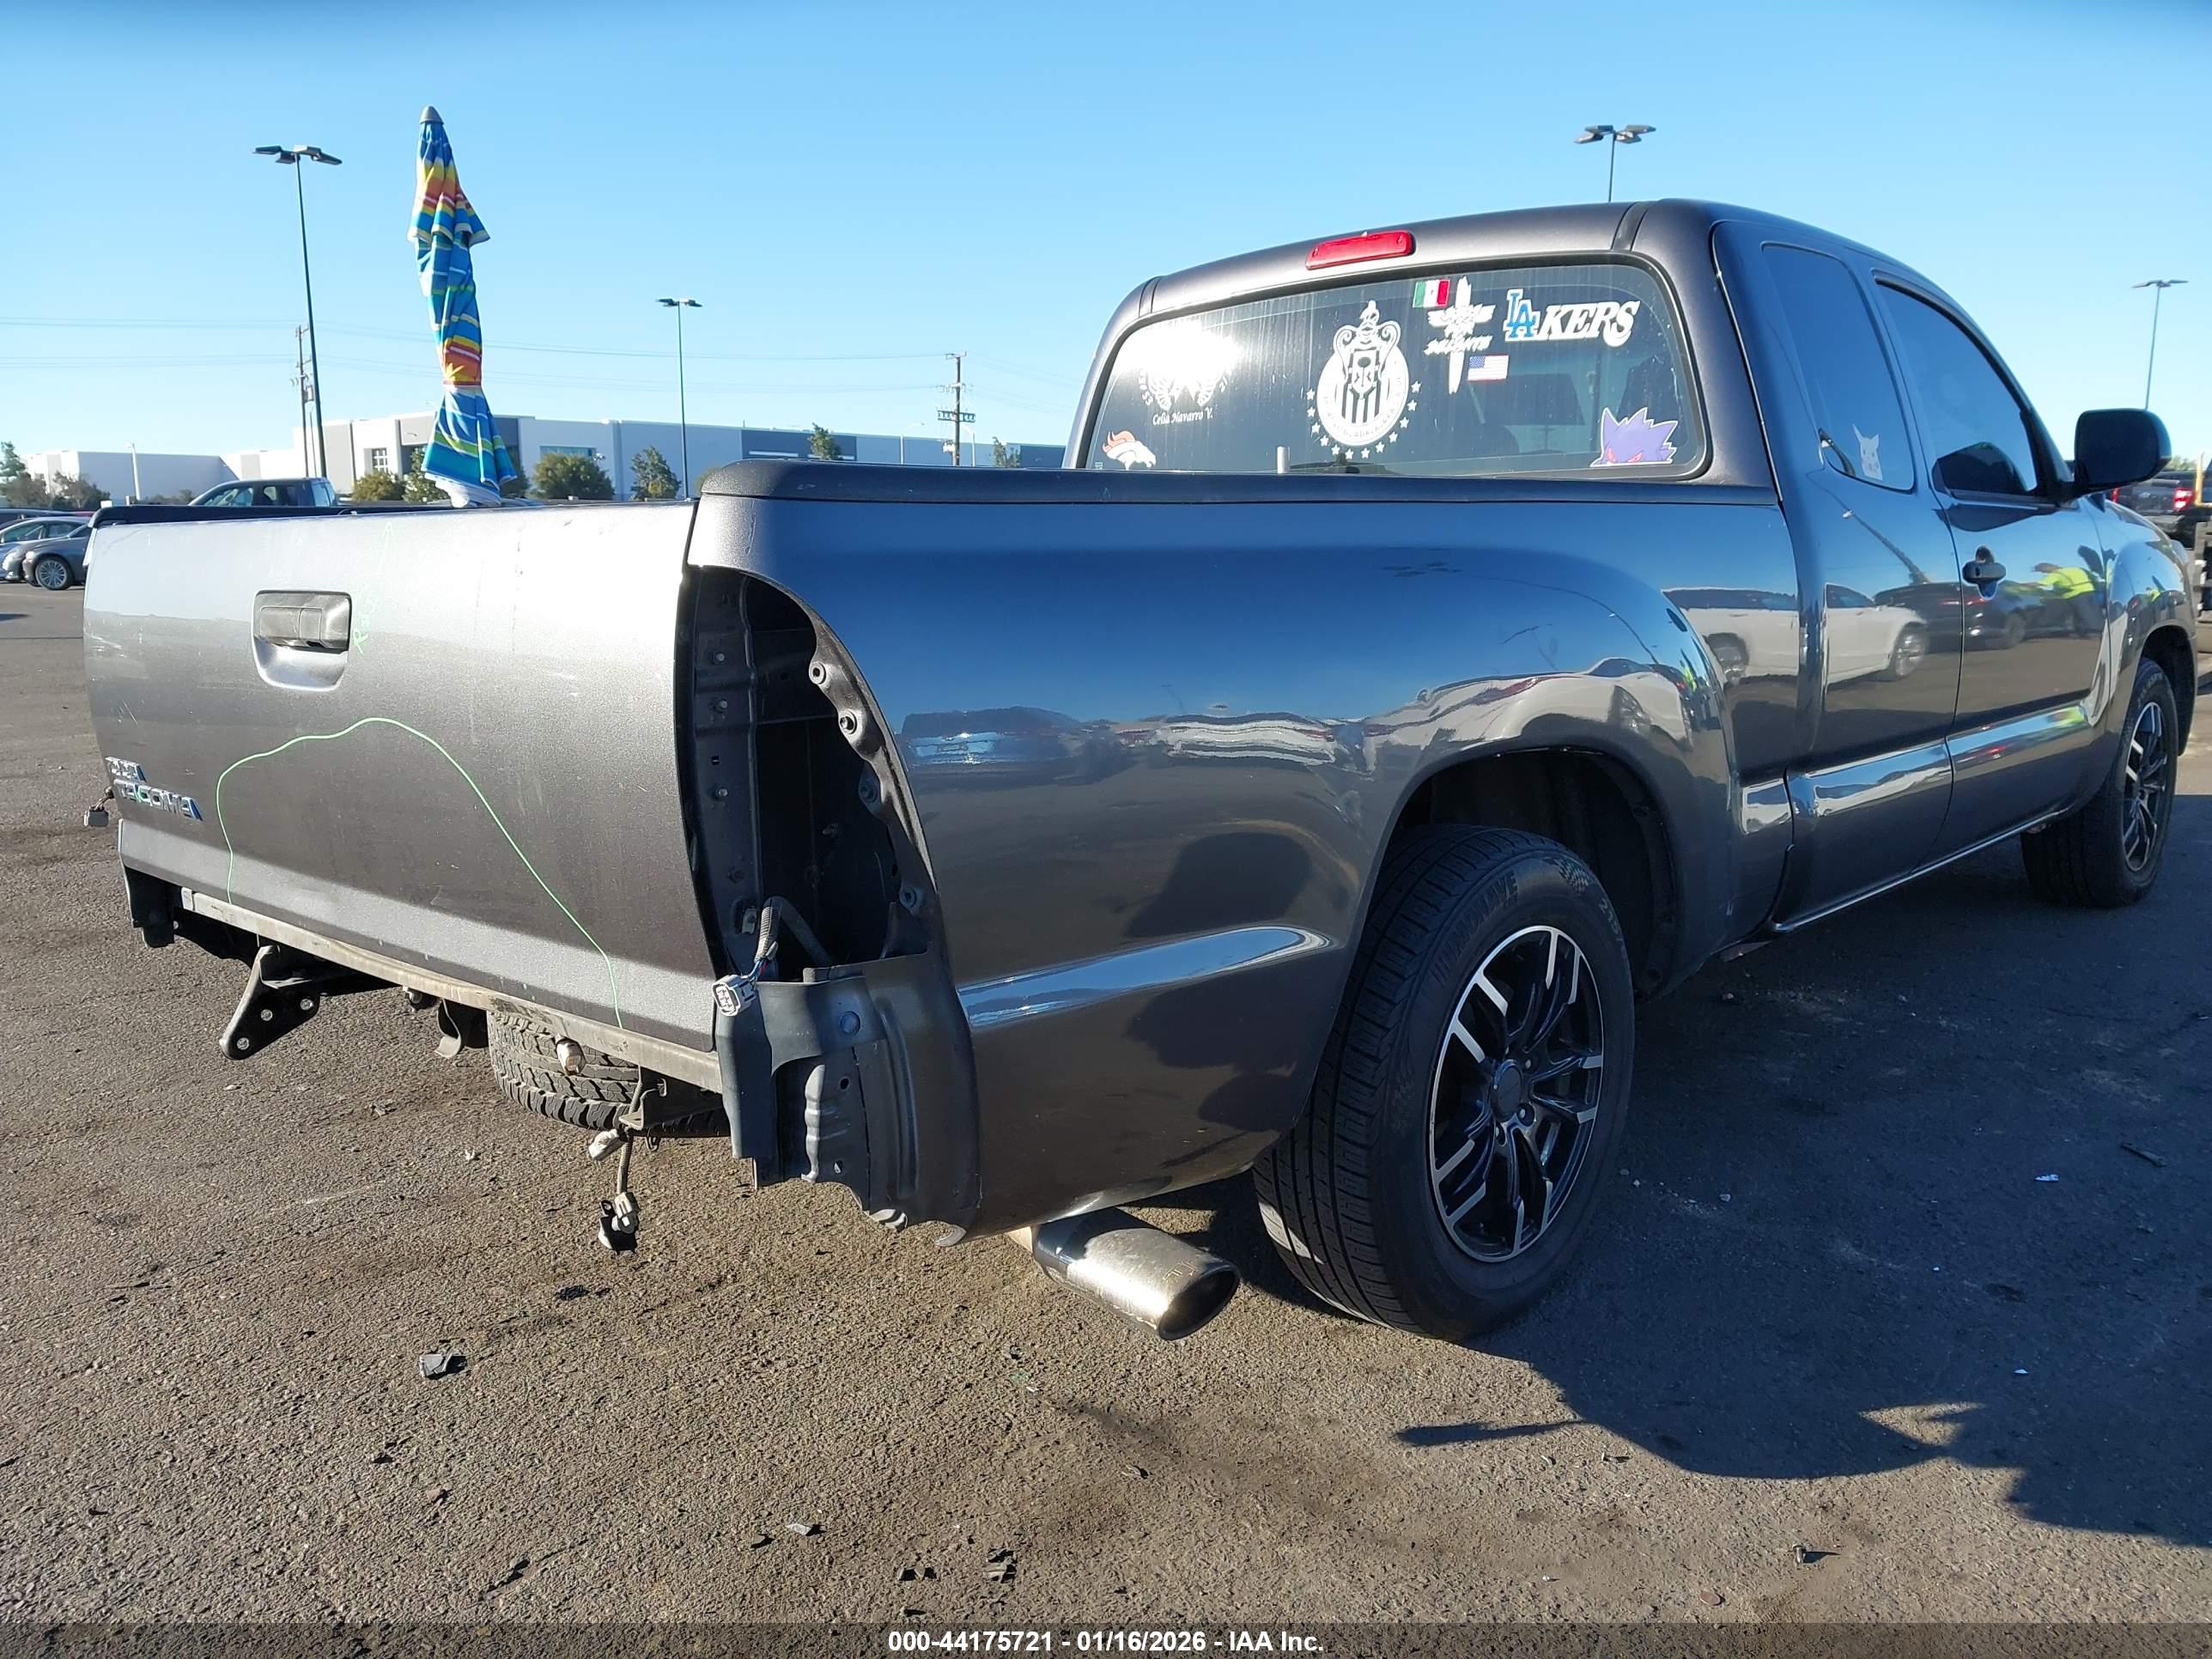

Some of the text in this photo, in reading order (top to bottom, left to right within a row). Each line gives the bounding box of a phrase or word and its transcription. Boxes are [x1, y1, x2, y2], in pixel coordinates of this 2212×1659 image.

[1503, 289, 1641, 348] LAKERS
[1170, 411, 1204, 423] Navarro
[113, 778, 204, 822] TACOMA
